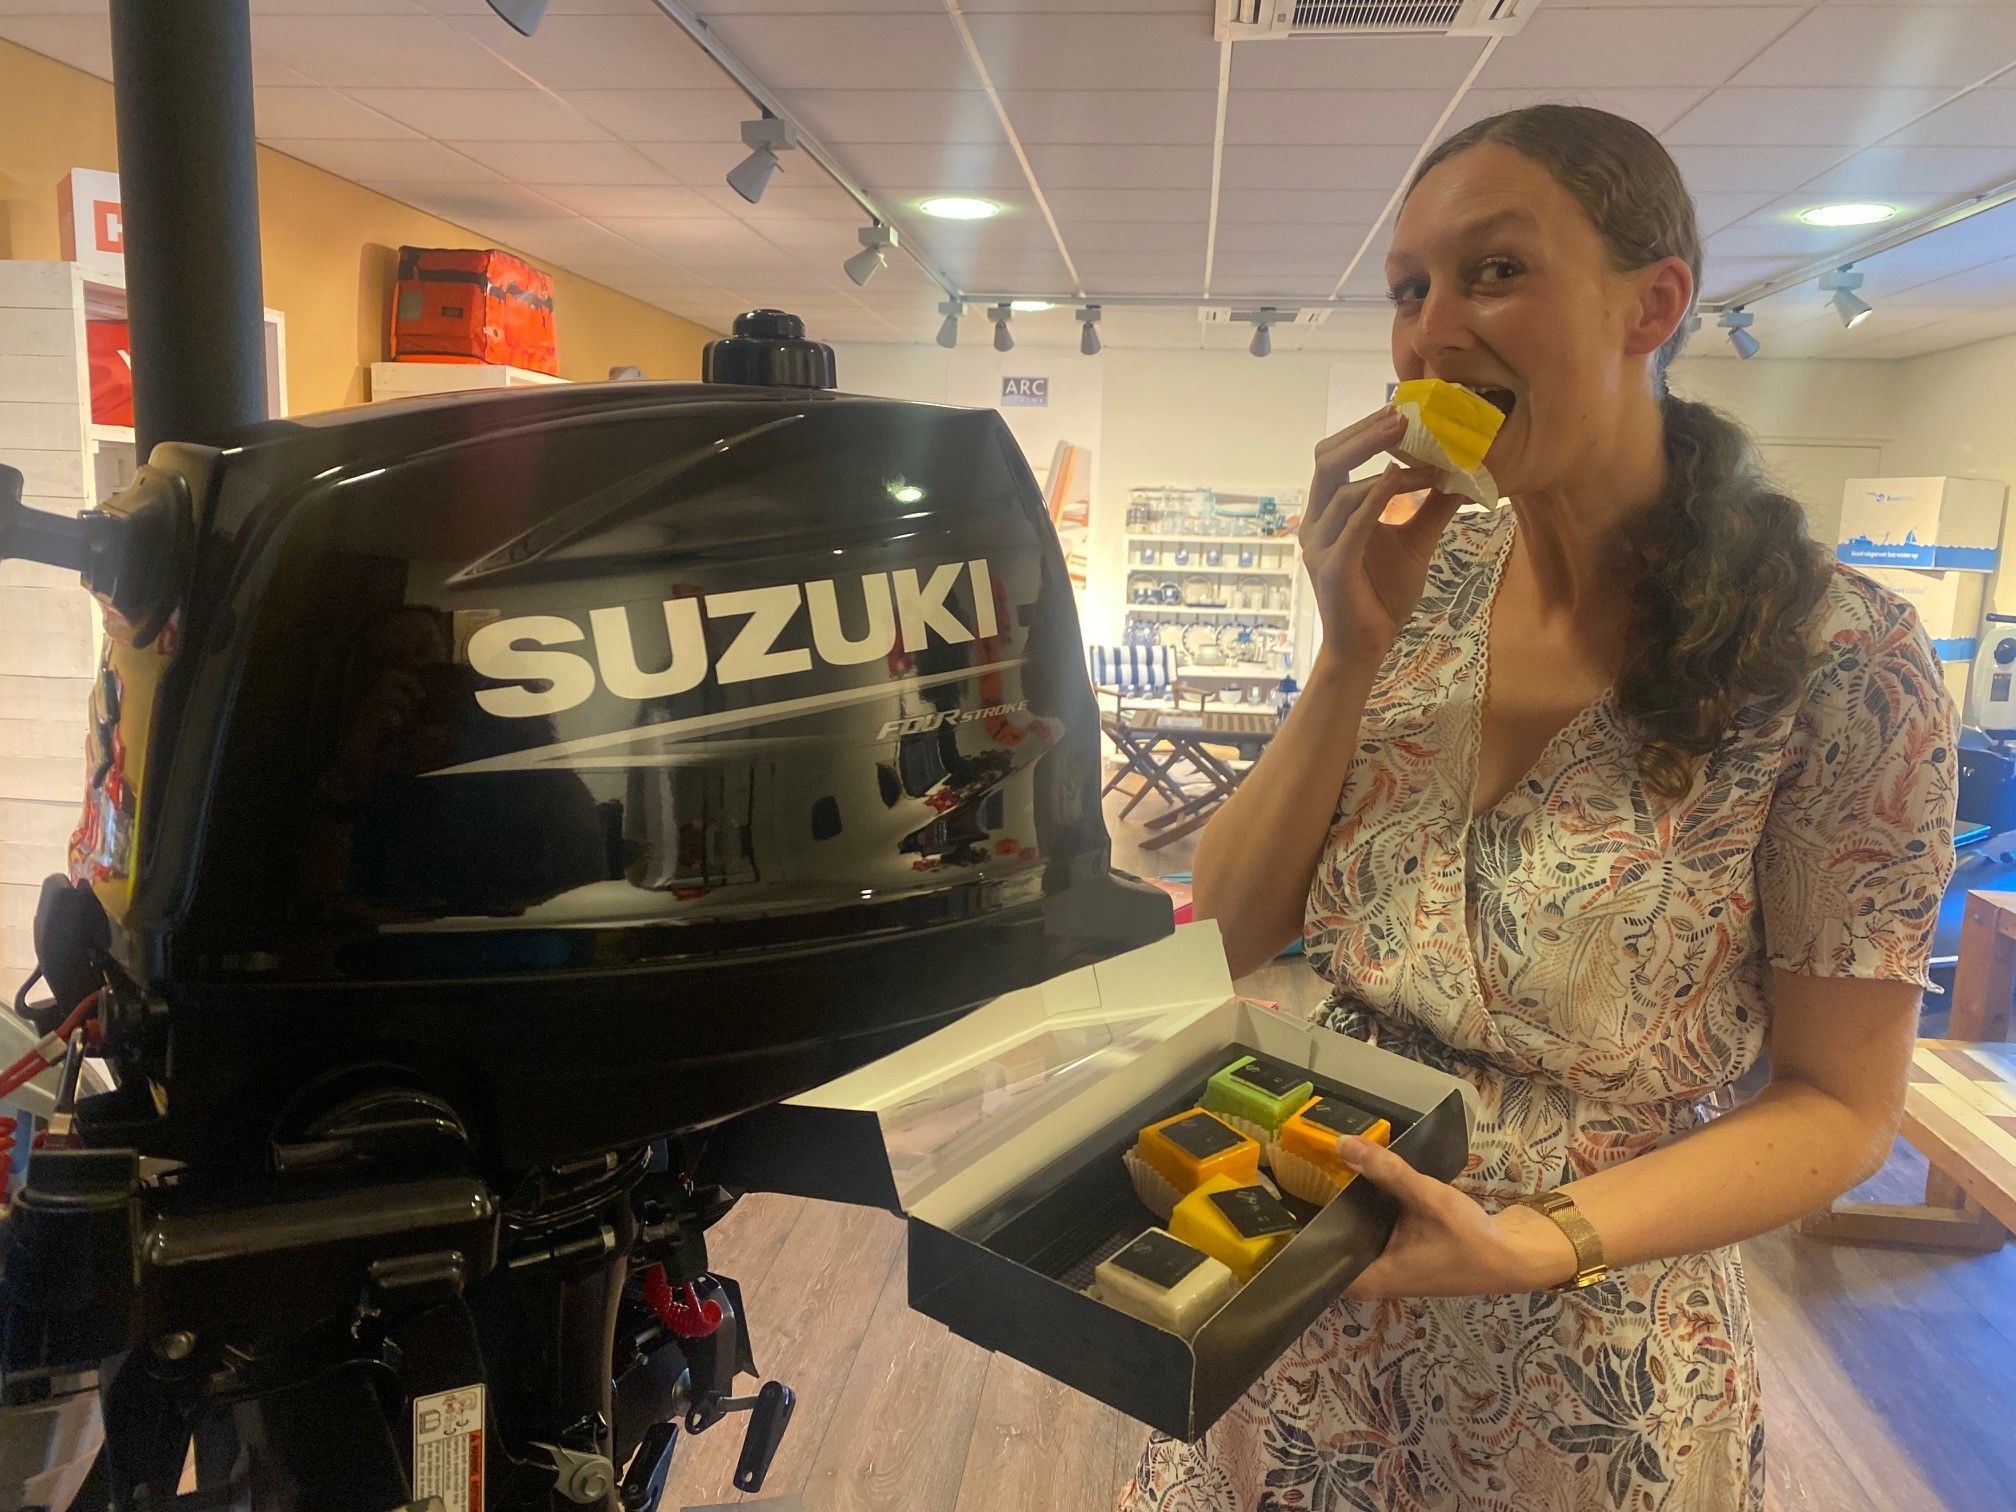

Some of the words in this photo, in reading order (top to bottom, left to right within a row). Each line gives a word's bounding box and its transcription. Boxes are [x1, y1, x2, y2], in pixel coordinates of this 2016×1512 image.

[1004, 379, 1045, 395] ARC
[467, 558, 999, 718] SUZUKI
[876, 708, 961, 740] FOUR
[959, 699, 1029, 723] STROKE
